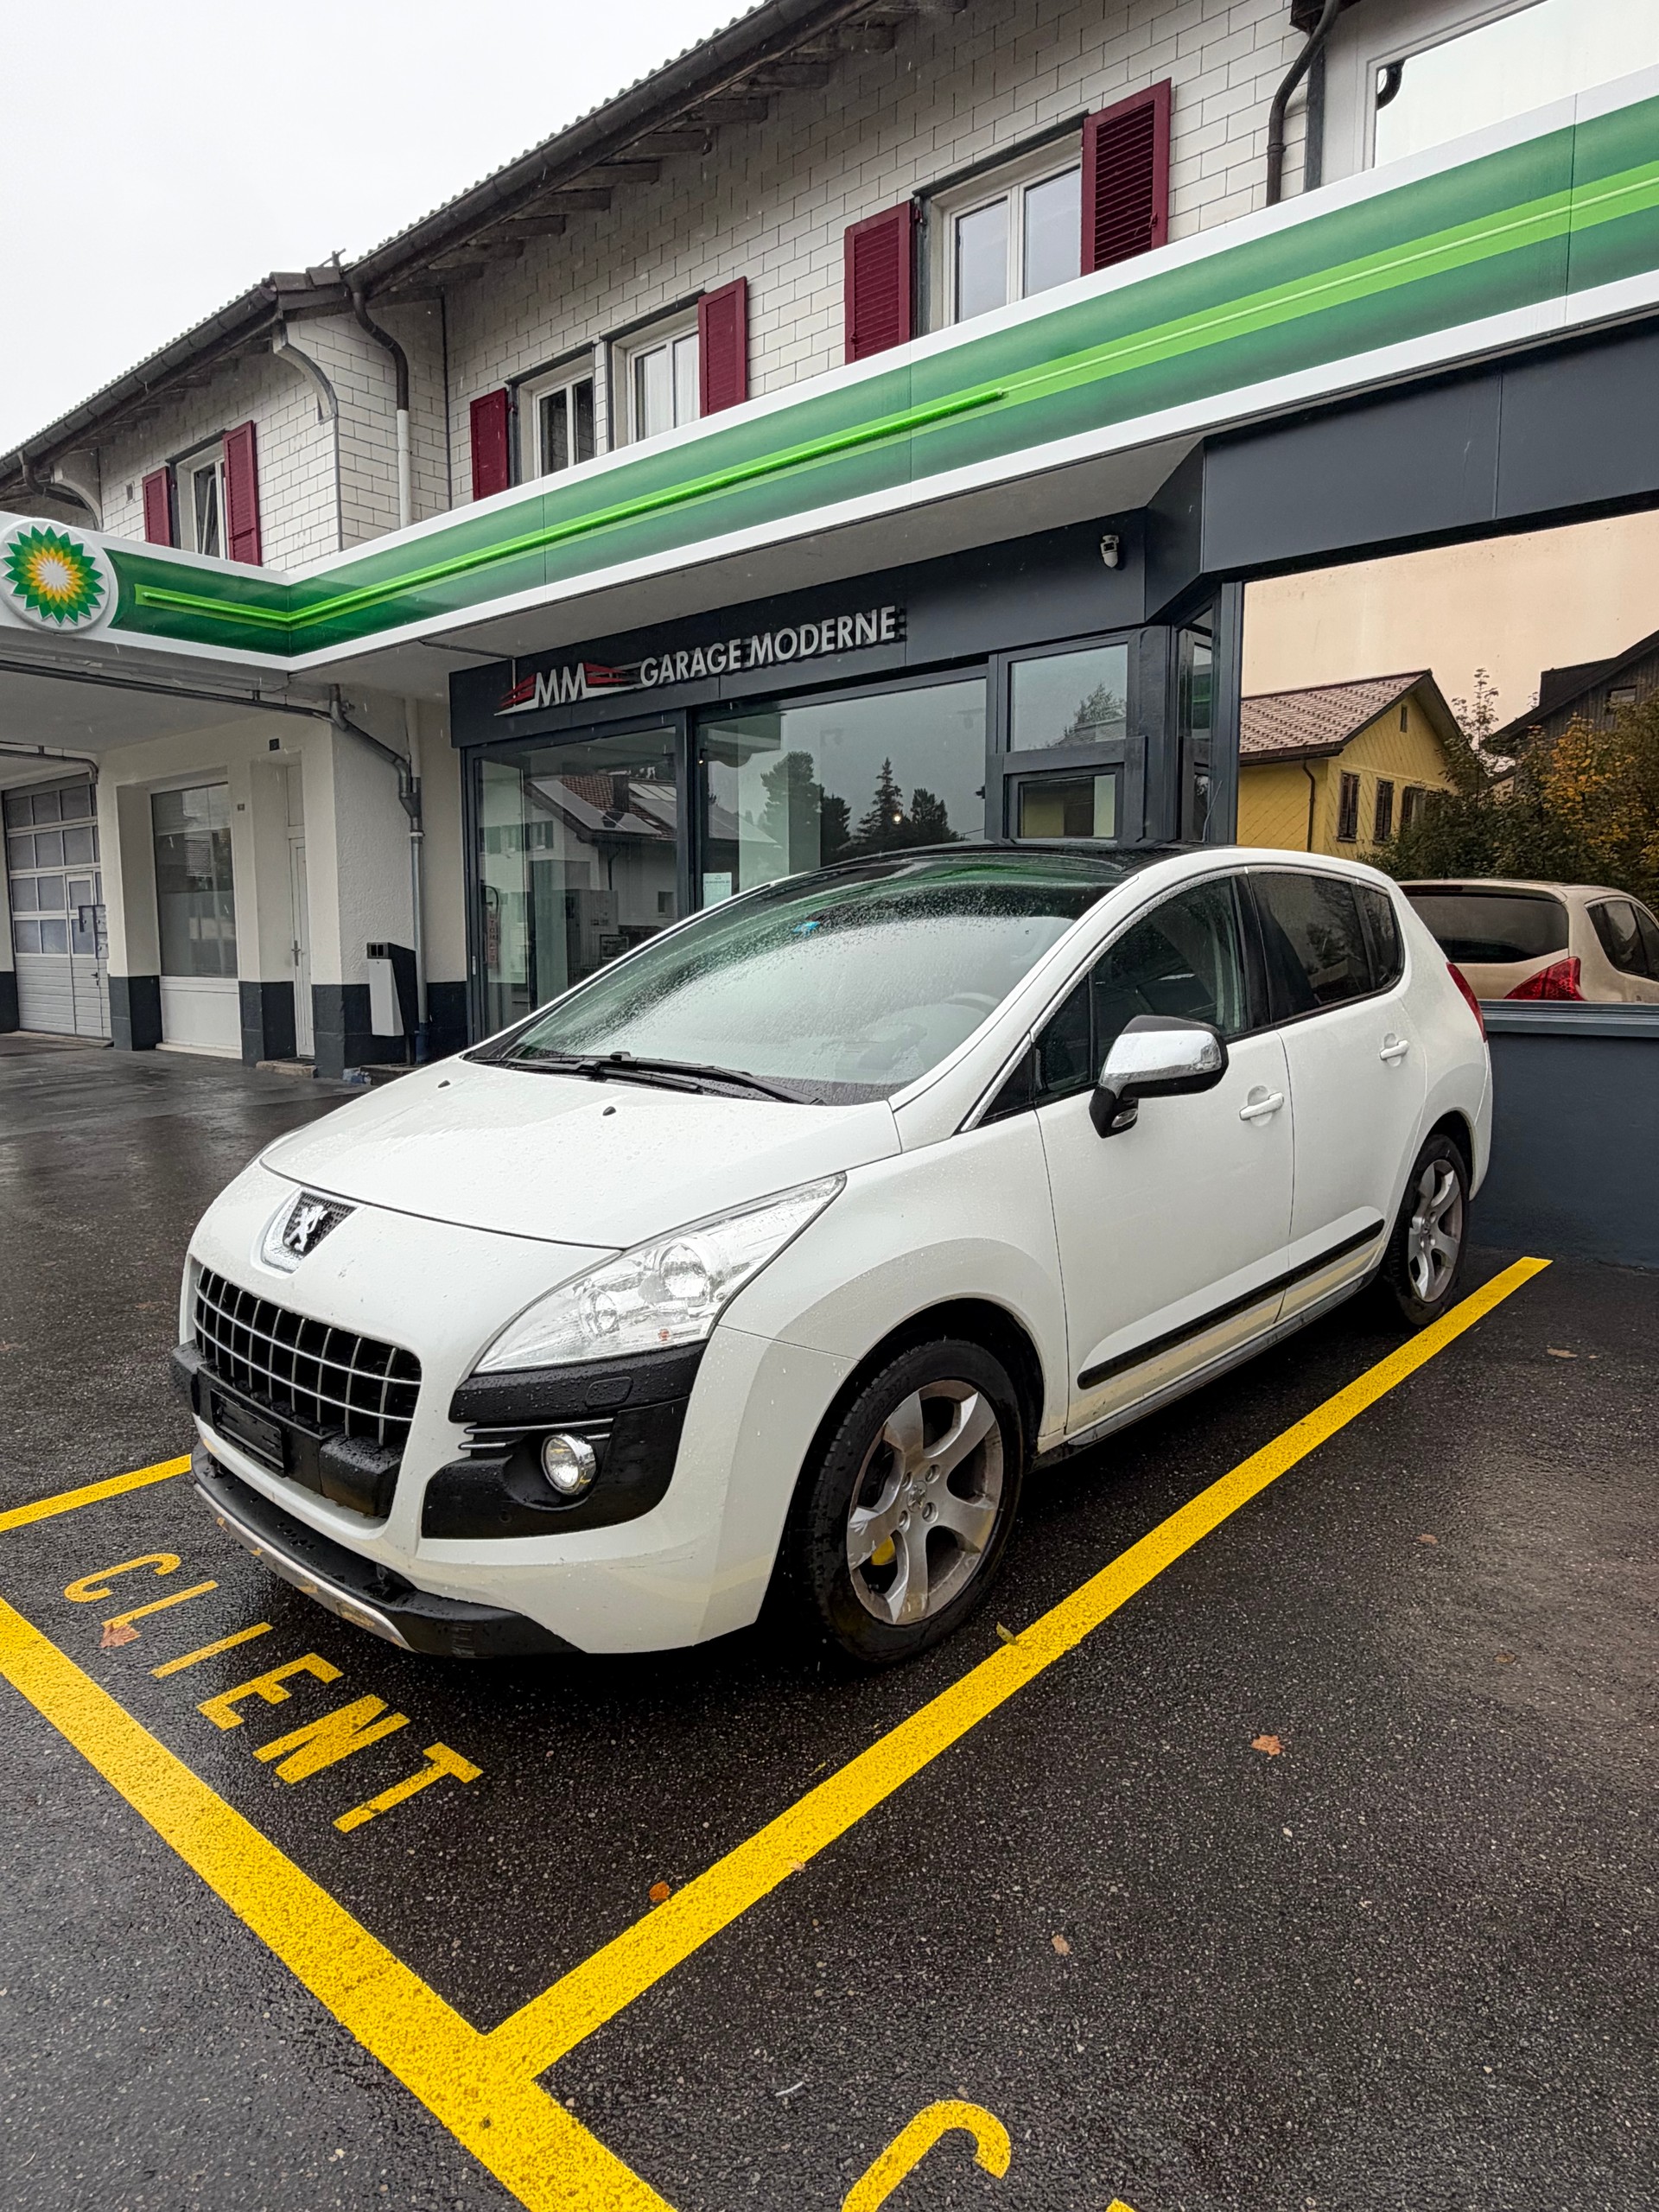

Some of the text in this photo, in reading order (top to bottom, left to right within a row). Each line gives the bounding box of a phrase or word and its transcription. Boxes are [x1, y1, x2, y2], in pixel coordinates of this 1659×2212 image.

[533, 606, 897, 709] MM GARAGE MODERNE
[64, 1553, 484, 1834] CLIENT
